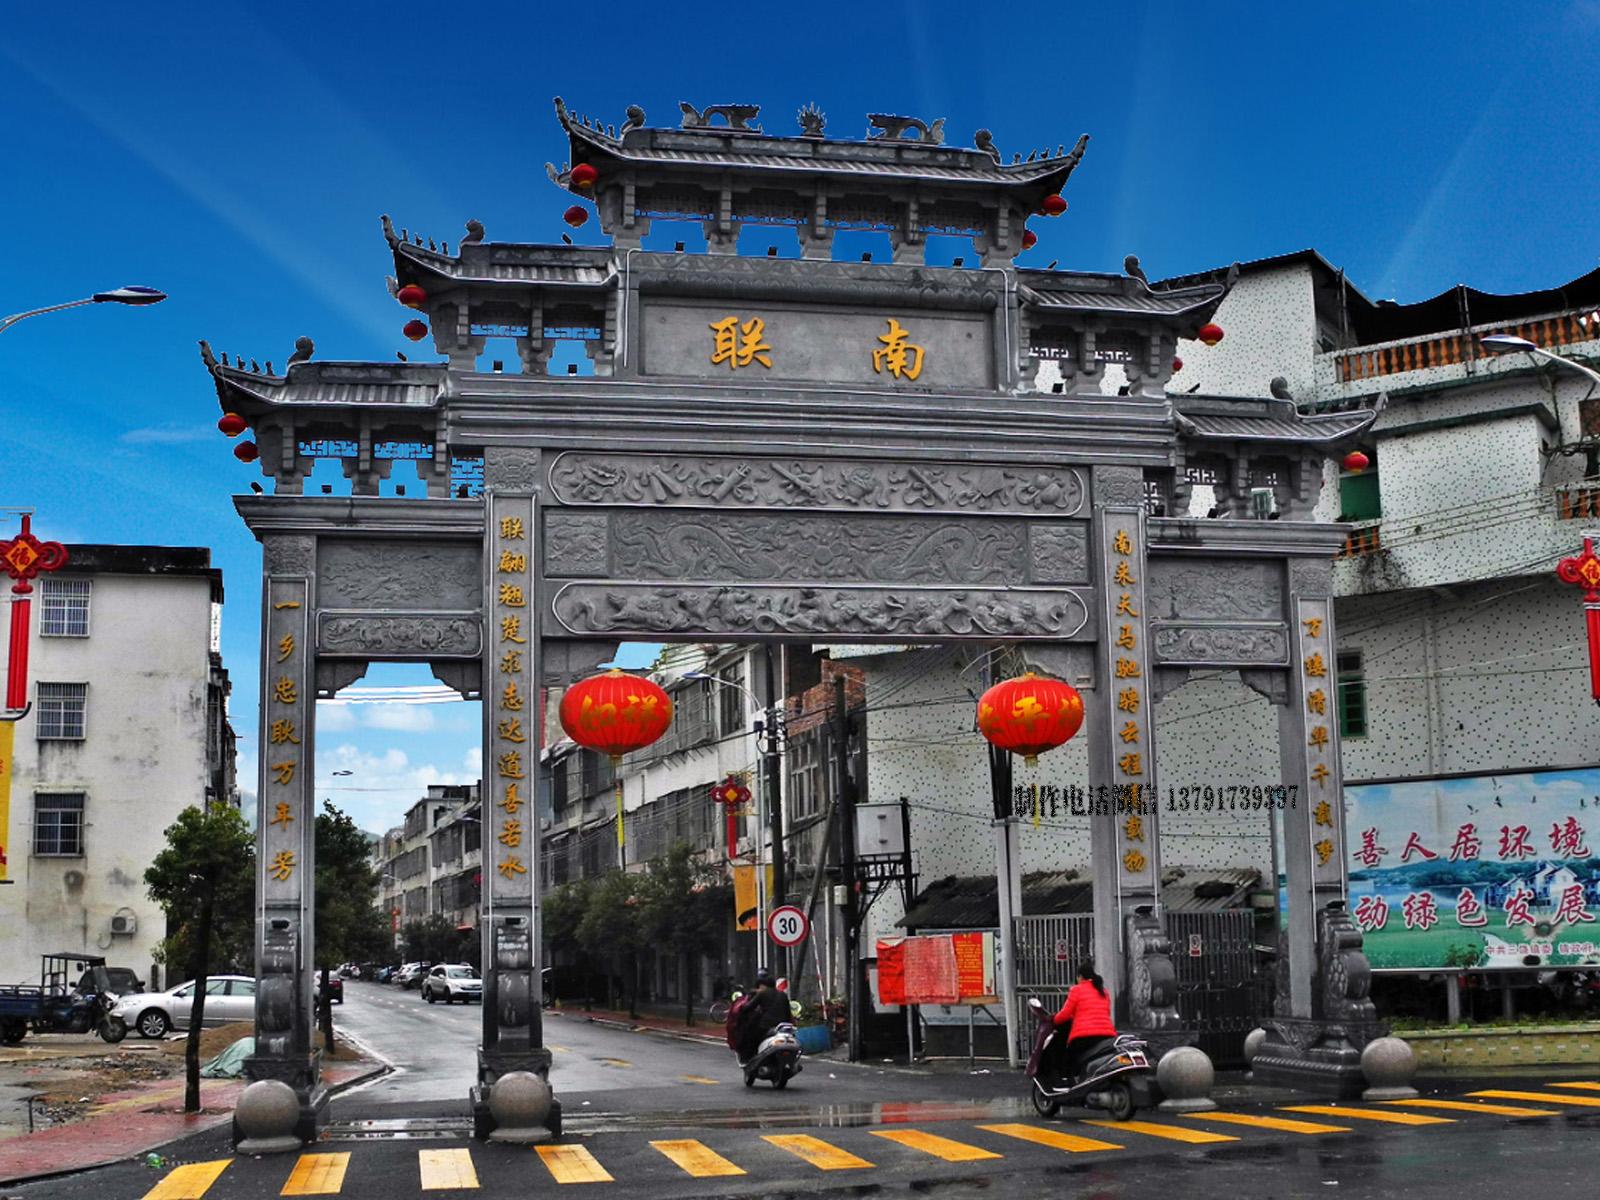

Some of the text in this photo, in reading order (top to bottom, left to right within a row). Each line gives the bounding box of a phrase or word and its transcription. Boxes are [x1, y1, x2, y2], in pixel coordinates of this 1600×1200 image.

[1354, 816, 1590, 866] 善人居环境
[779, 917, 797, 935] 30
[1354, 884, 1595, 930] 动绿色发展
